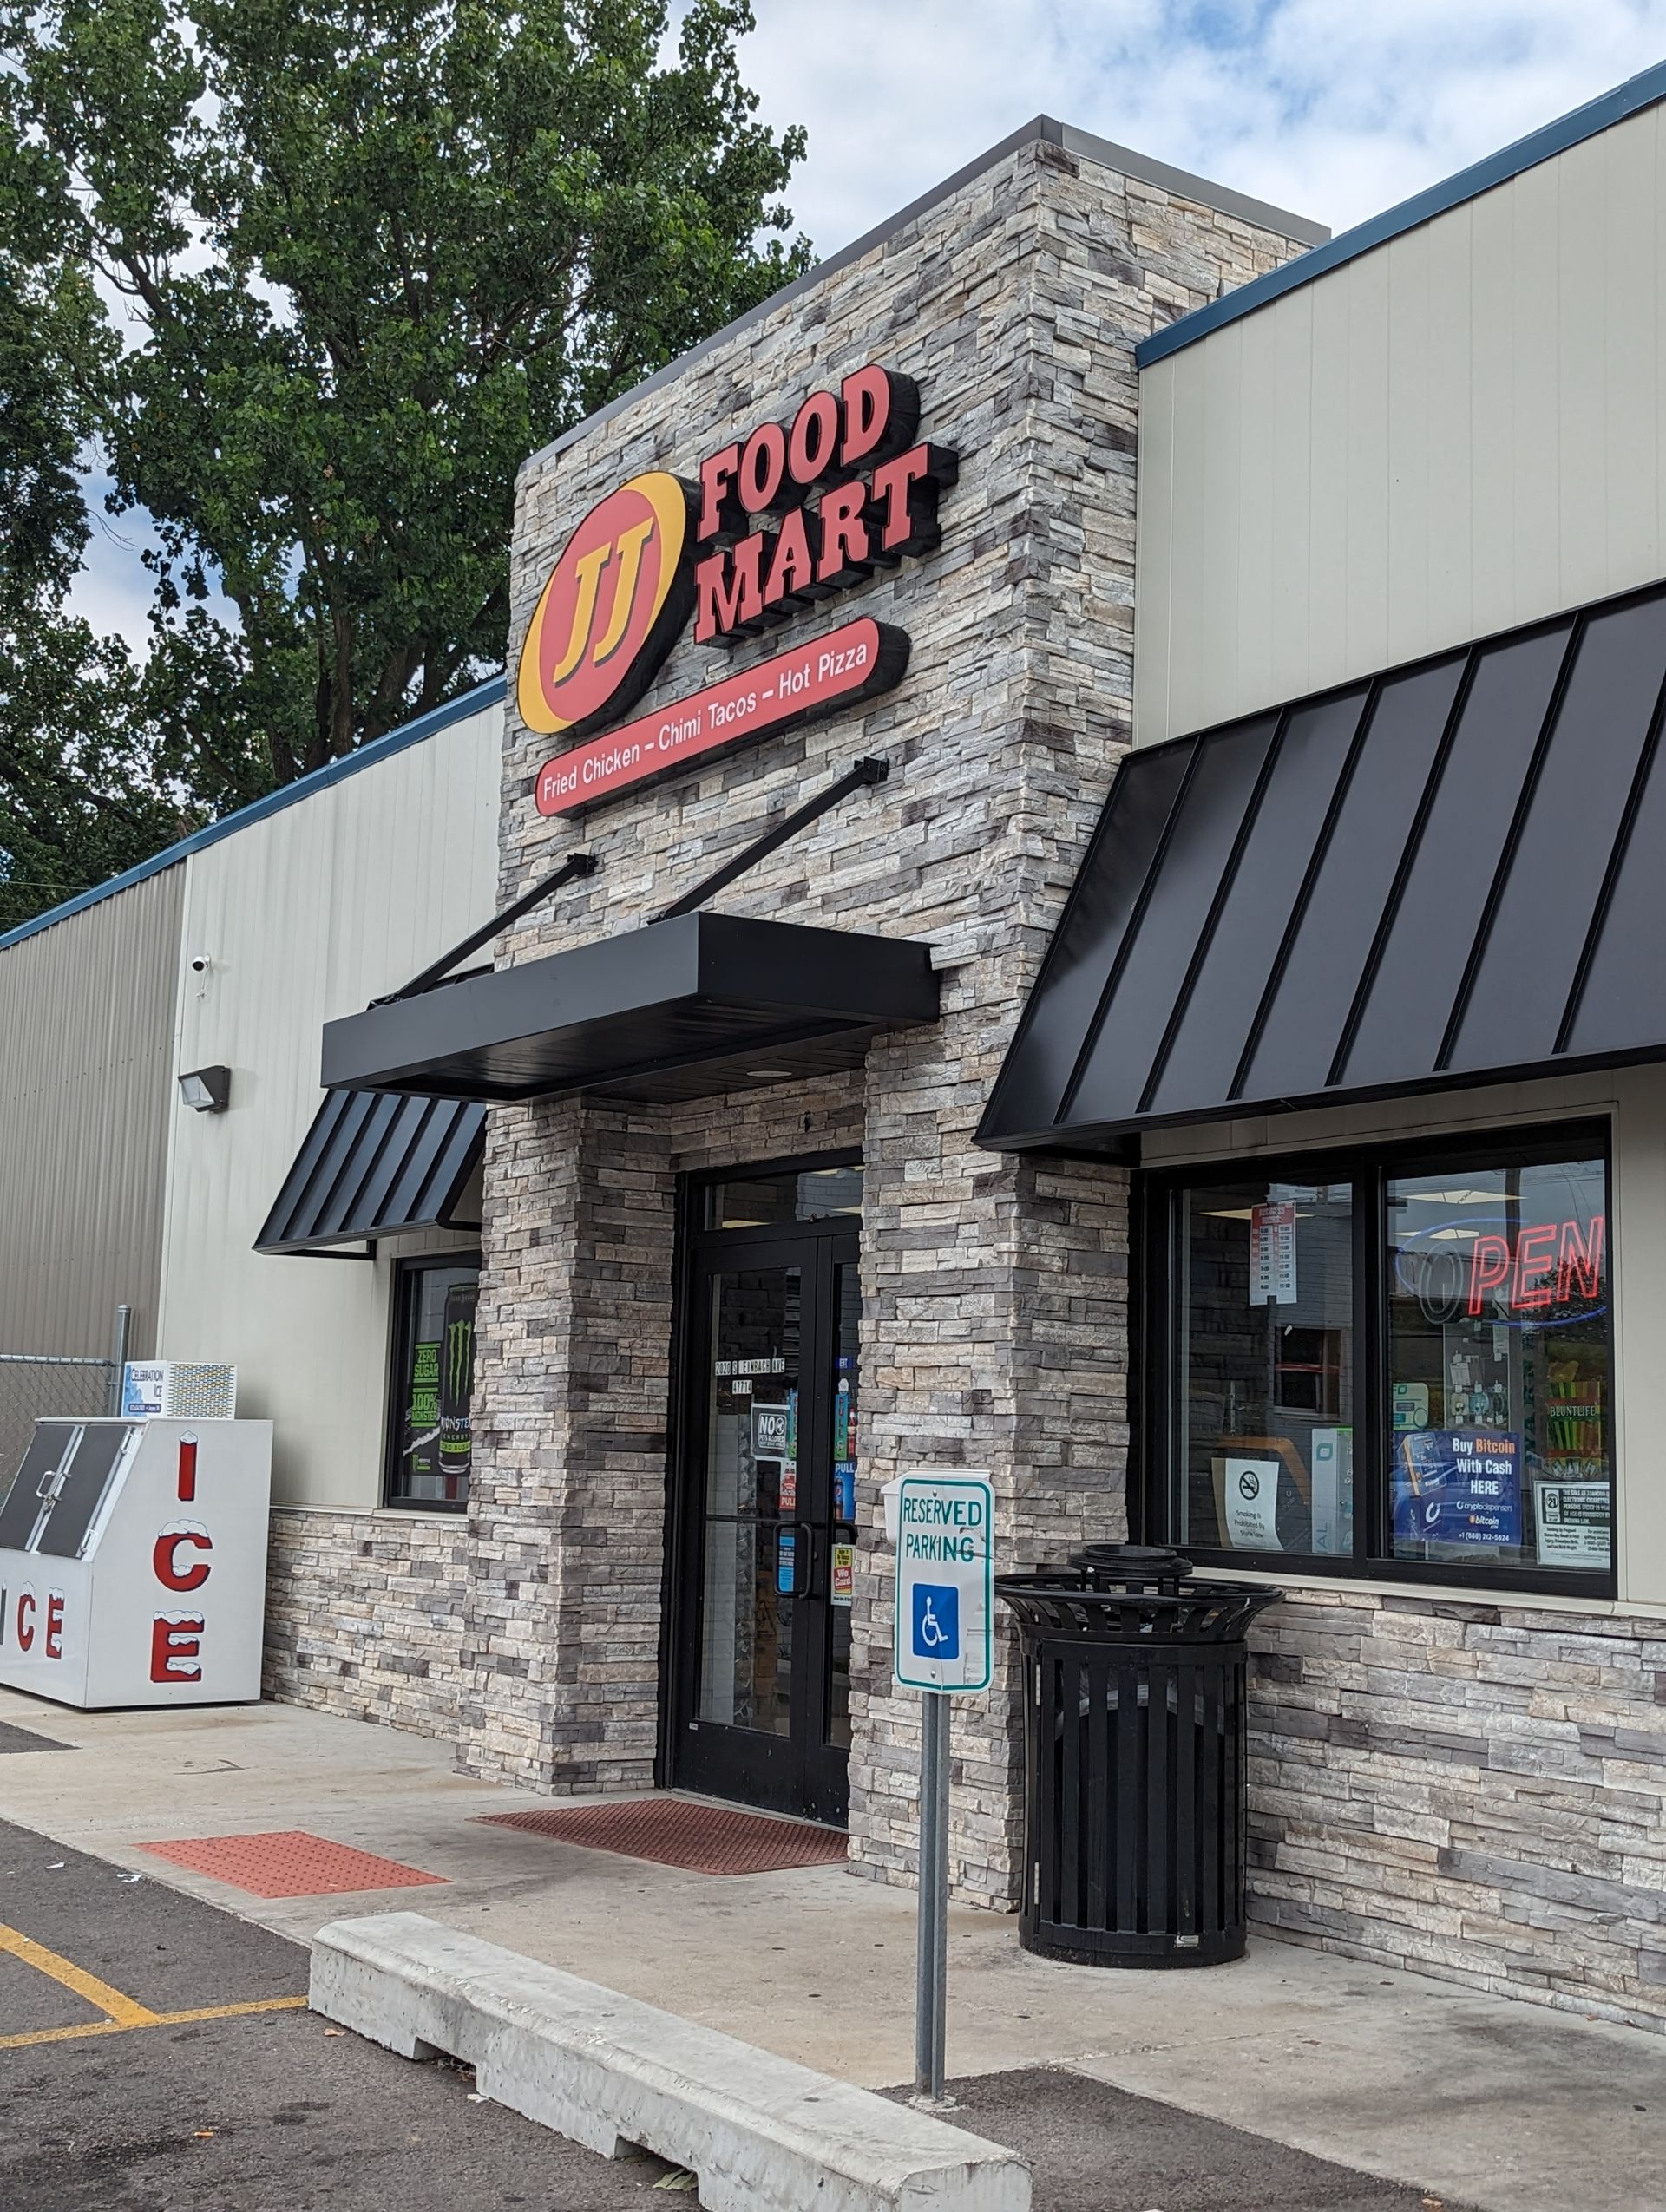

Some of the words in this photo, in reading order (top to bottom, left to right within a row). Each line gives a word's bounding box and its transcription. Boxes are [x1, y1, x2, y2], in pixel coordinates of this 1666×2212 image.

[697, 363, 890, 544] FOOD
[694, 442, 930, 645] MART
[554, 516, 655, 686] JJ
[543, 770, 577, 802] Fried
[582, 742, 640, 785] Chicken
[659, 710, 701, 752] Chimi
[708, 690, 757, 730] Tacos
[779, 665, 810, 702] Hot
[818, 642, 868, 683] Pizza
[1418, 1216, 1604, 1325] OPEN
[417, 1349, 437, 1363] ZERO
[414, 1363, 439, 1378] SUGAR
[772, 1358, 785, 1372] AVE
[131, 1368, 164, 1382] CELEBRATION
[411, 1393, 437, 1410] 100%
[1550, 1404, 1597, 1417] BLUNTLIFE
[441, 1416, 470, 1431] MONSTE
[758, 1416, 776, 1436] NO
[1453, 1437, 1473, 1456] Buy
[1476, 1438, 1516, 1455] Bitcoin
[835, 1463, 855, 1474] PULL
[1456, 1458, 1482, 1474] With
[1485, 1459, 1512, 1475] Cash
[1470, 1479, 1499, 1495] HERE
[1548, 1497, 1557, 1507] 21
[903, 1497, 982, 1527] RESERVED
[1475, 1515, 1499, 1525] bitcoin
[906, 1533, 974, 1562] PARKING
[151, 1430, 213, 1683] ICE
[836, 1568, 849, 1577] We
[835, 1577, 851, 1587] Card
